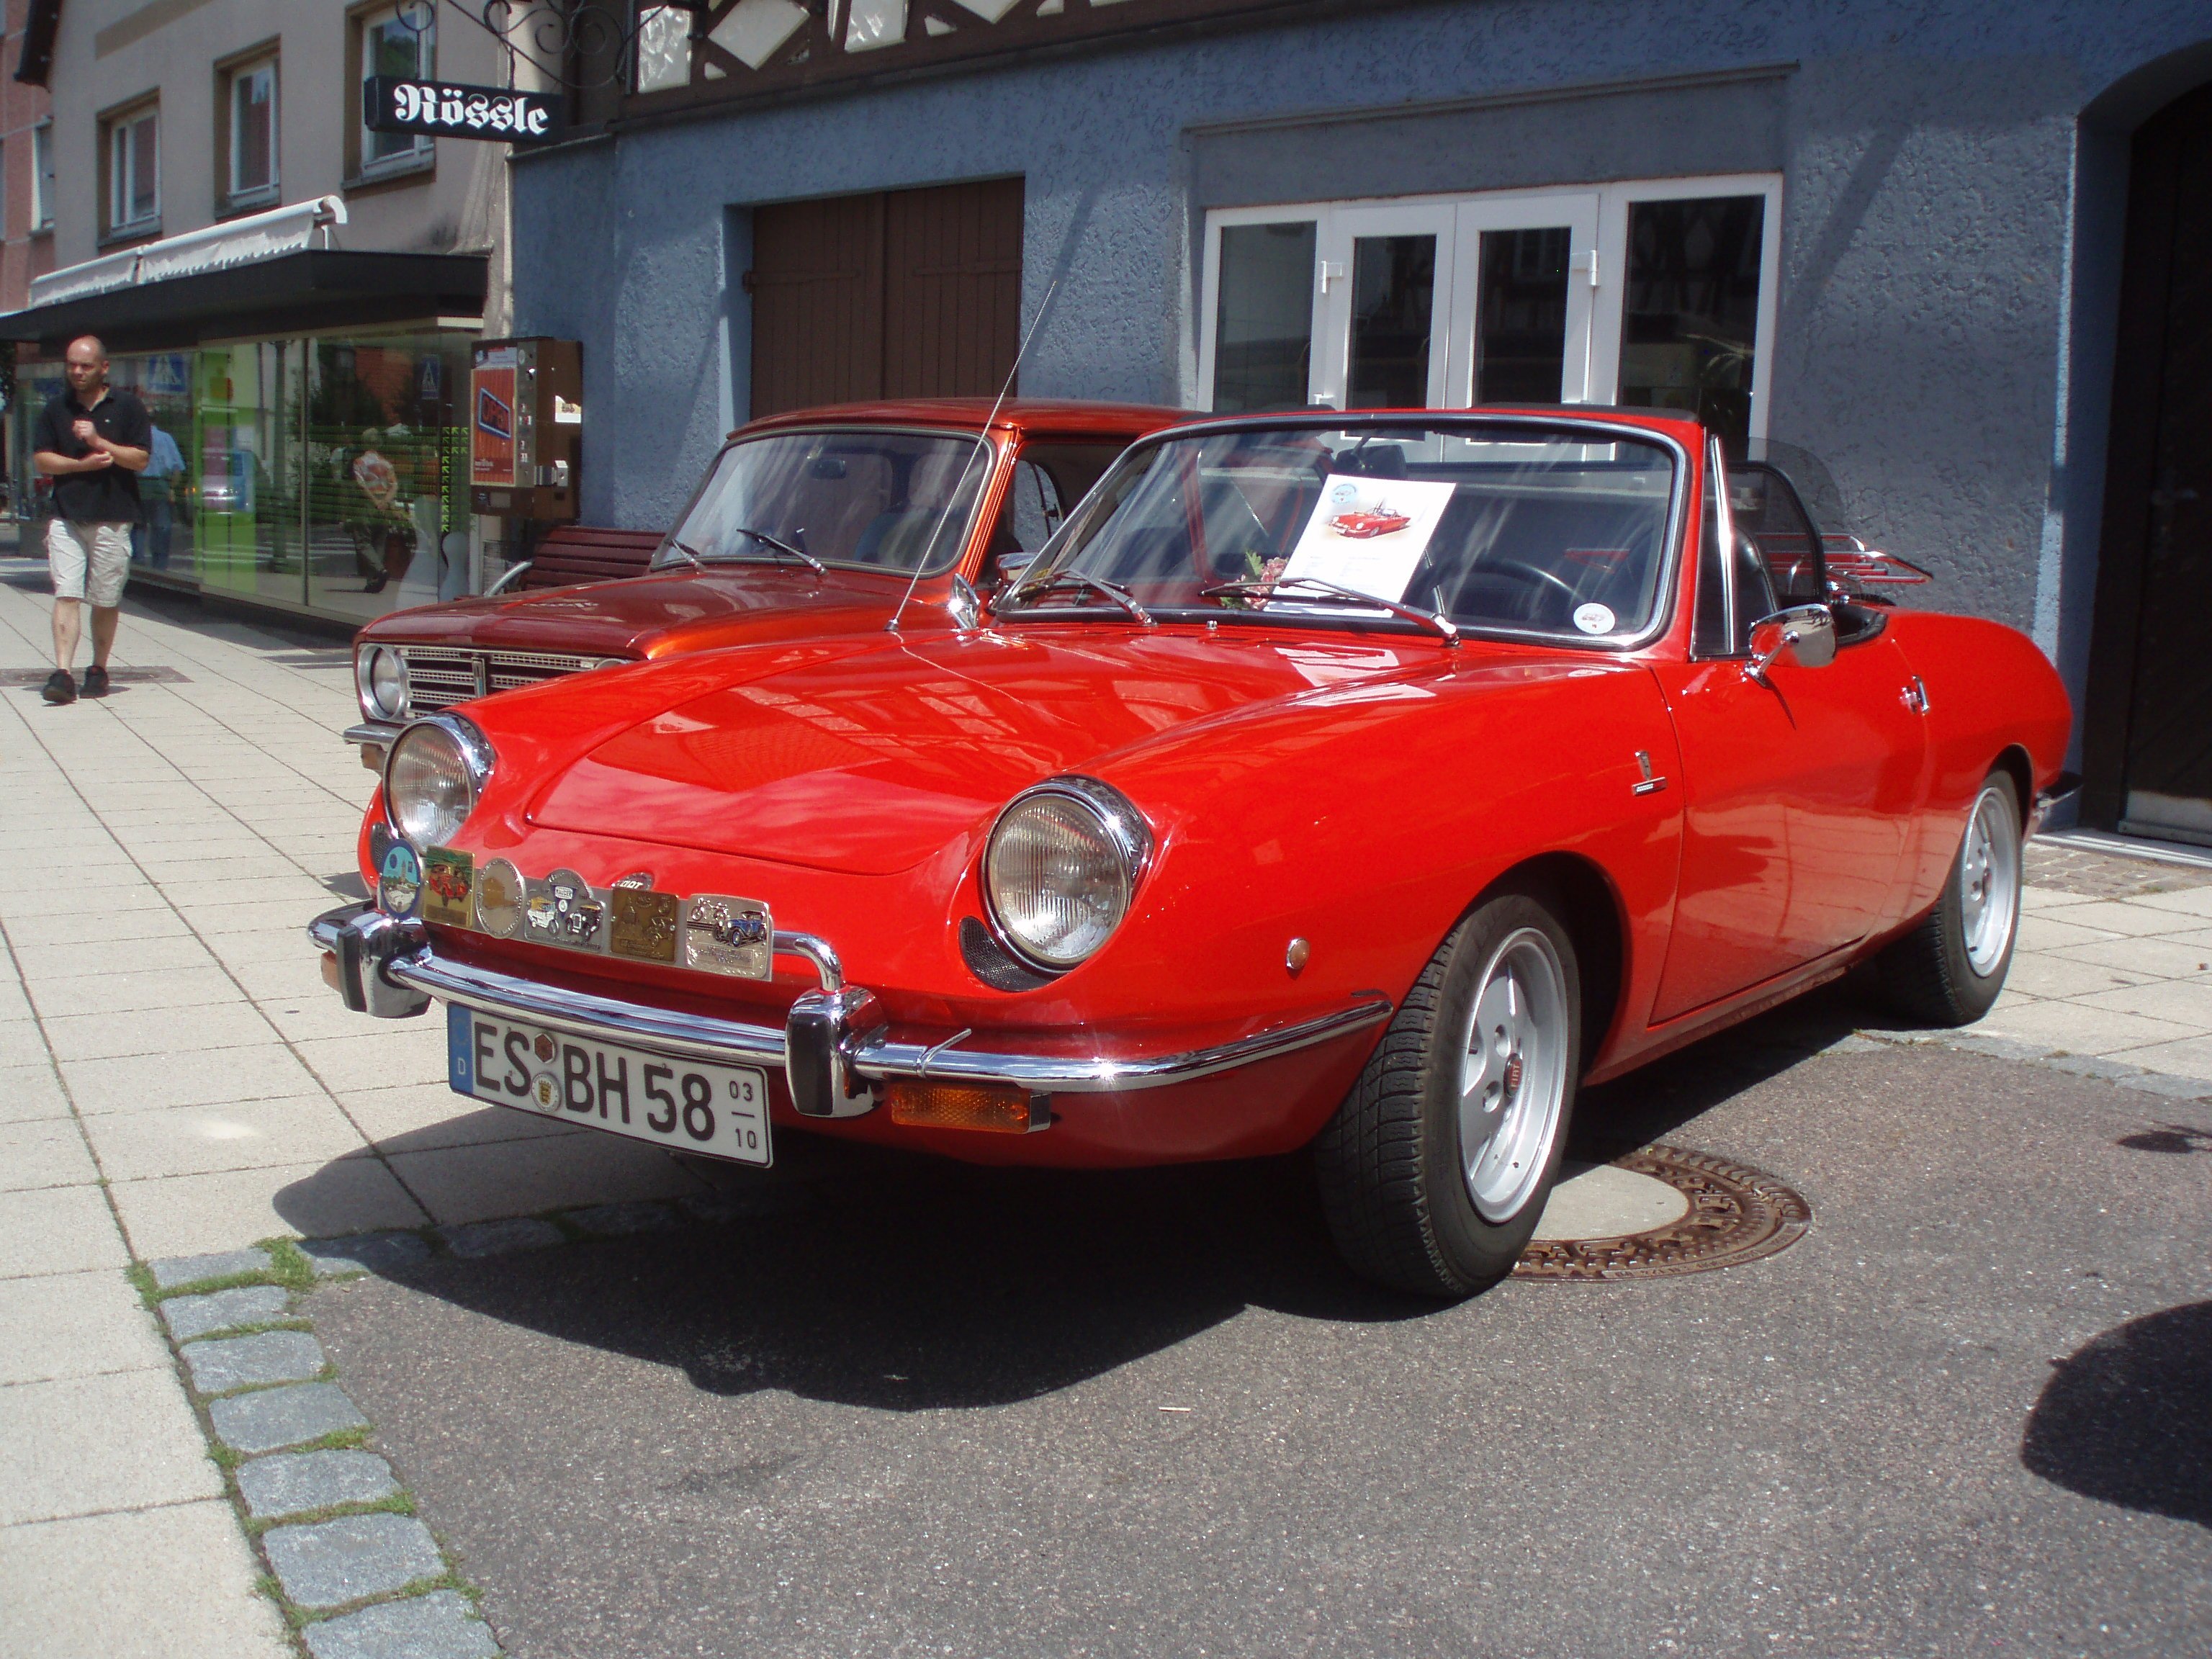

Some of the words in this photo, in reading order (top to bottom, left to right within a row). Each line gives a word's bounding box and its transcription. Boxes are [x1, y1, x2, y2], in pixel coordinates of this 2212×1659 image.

[394, 84, 549, 135] Rössle
[458, 1057, 466, 1075] D
[1511, 1064, 1520, 1087] FIAT
[474, 1021, 531, 1097] ES
[563, 1044, 630, 1124] BH
[643, 1063, 716, 1142] 58
[729, 1081, 753, 1102] 03
[735, 1128, 757, 1149] 10
